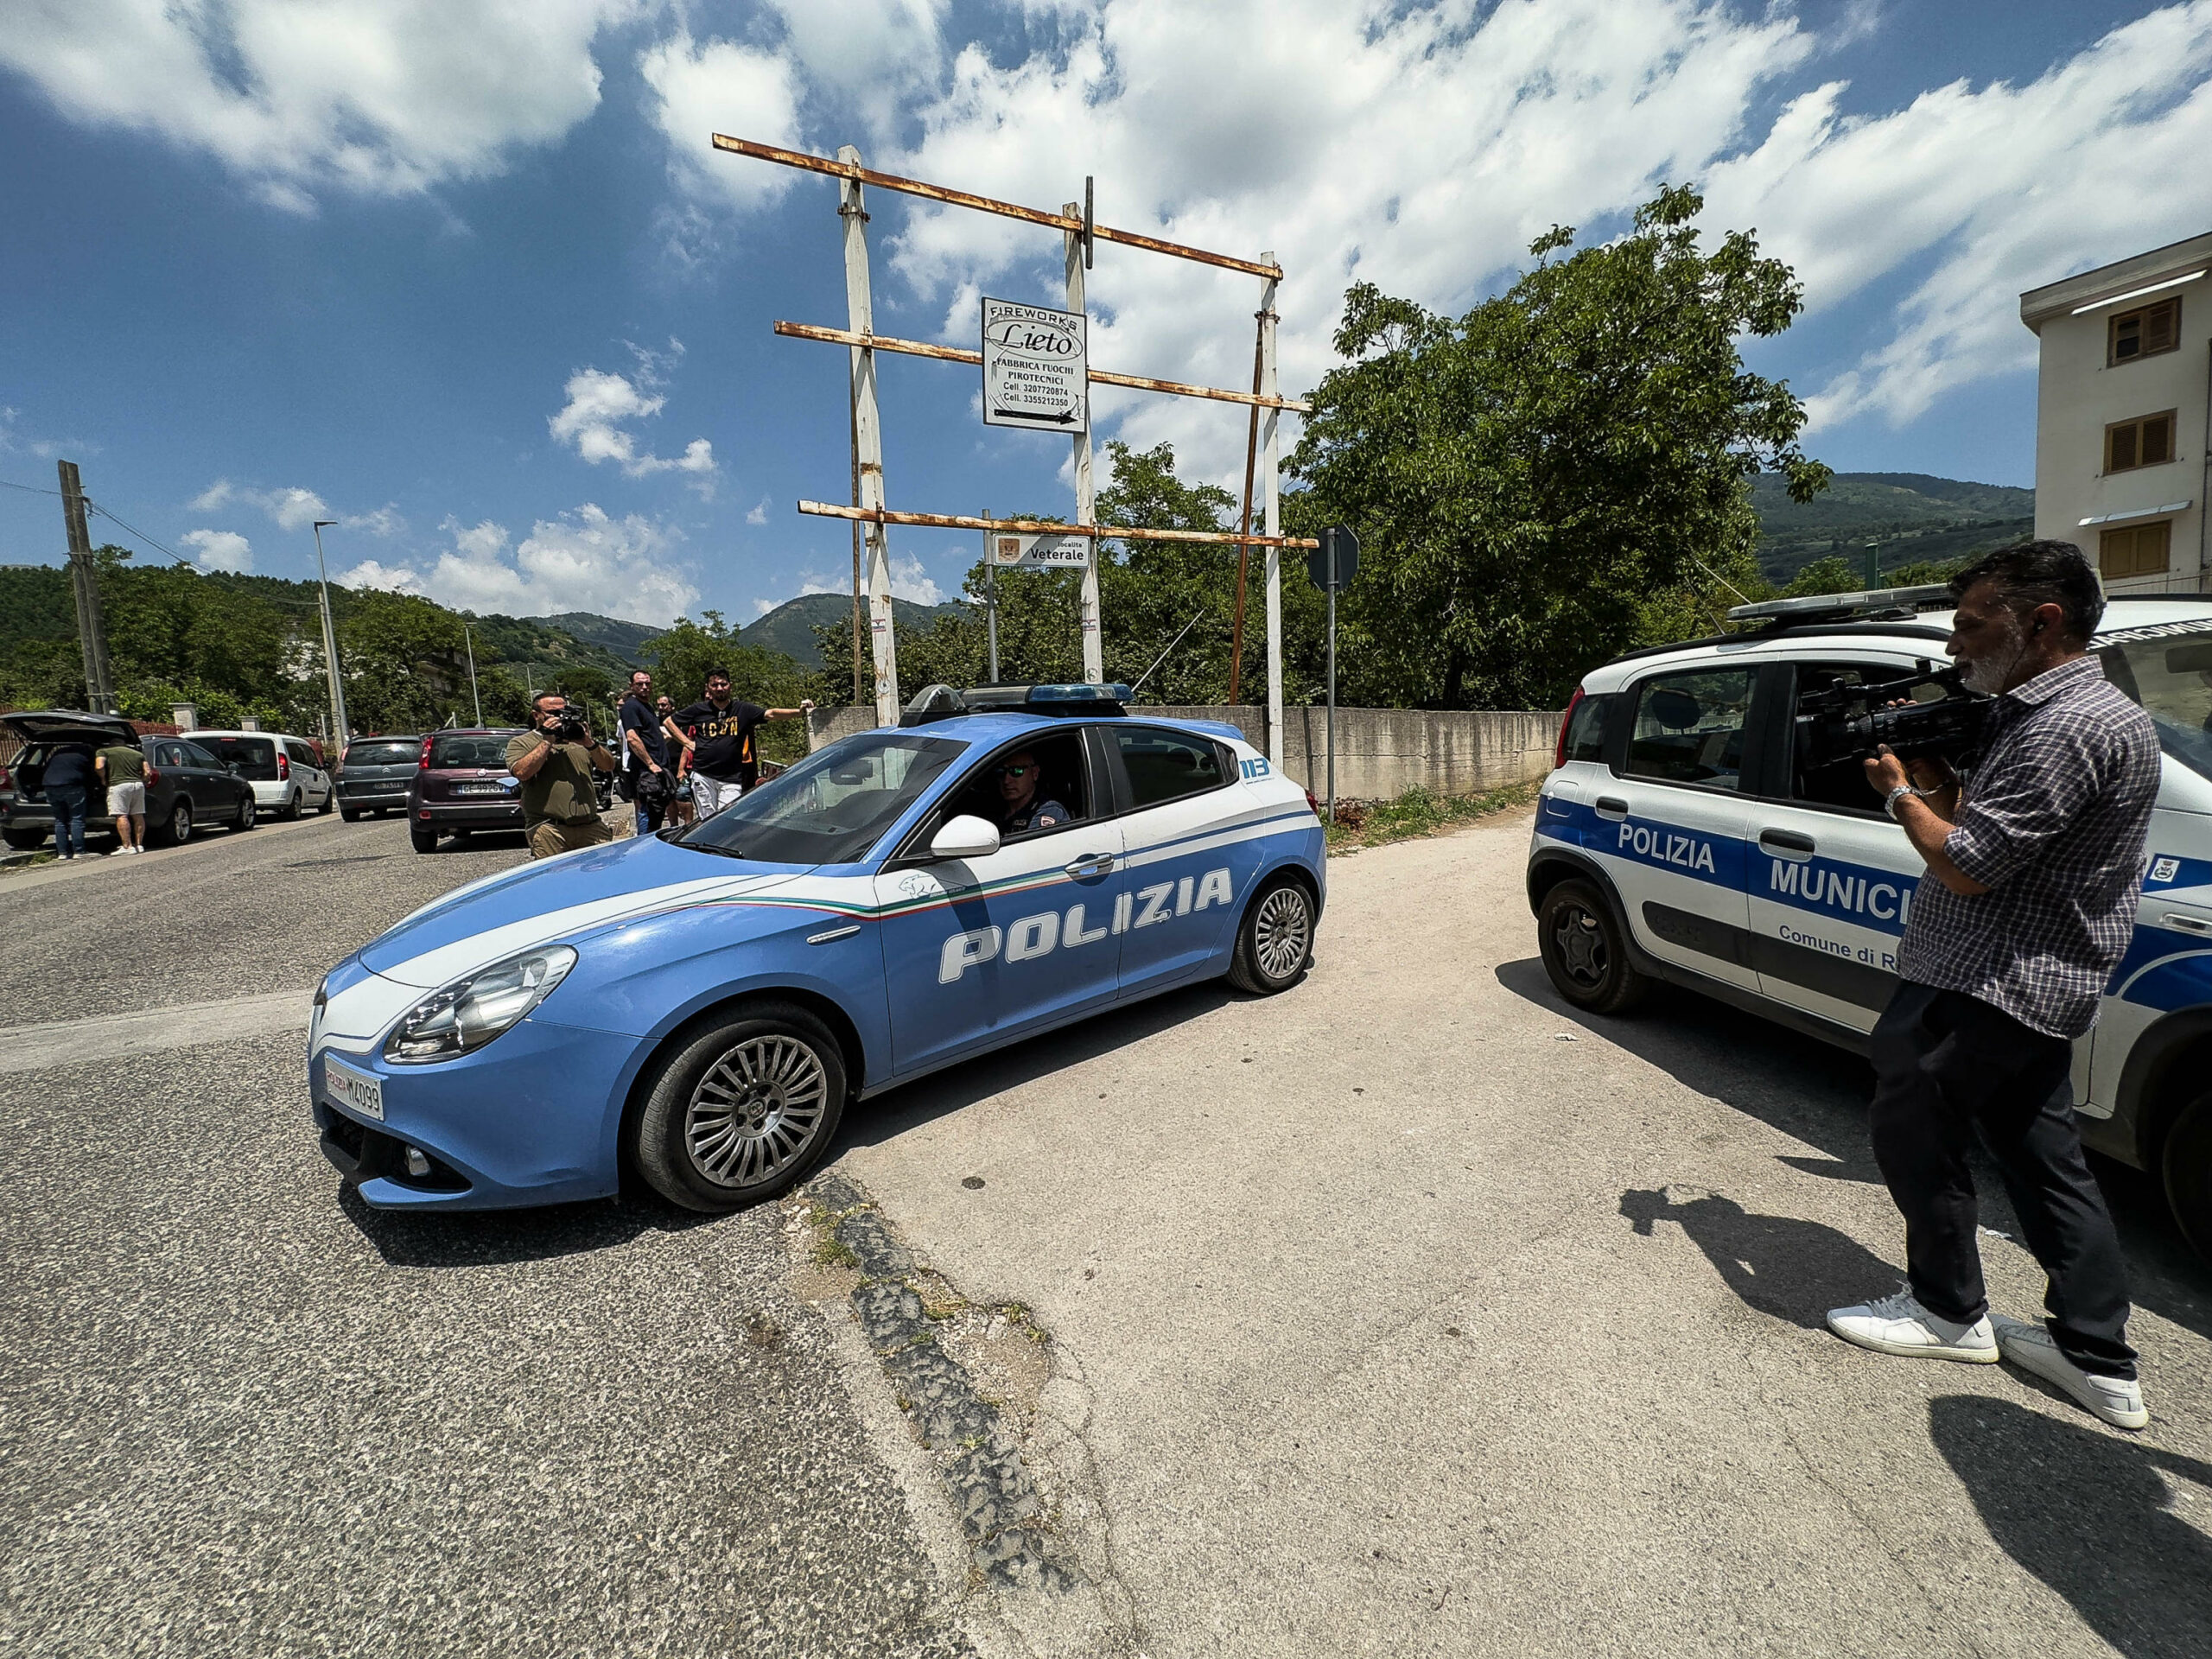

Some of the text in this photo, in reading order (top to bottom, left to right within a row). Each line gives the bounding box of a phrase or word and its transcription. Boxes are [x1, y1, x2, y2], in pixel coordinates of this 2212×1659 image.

[990, 307, 1077, 331] FIREWORKS
[998, 323, 1072, 354] Lieto
[996, 358, 1074, 375] FABBRICA FUOCHI
[1003, 381, 1068, 396] Cell. 3207720874
[1008, 371, 1064, 385] PIROTECNICI
[1003, 392, 1069, 407] Cell. 3355212350
[1030, 548, 1084, 561] Veterale
[1239, 757, 1270, 779] 113
[1618, 823, 1911, 925] POLIZIA MUNICI
[938, 868, 1232, 984] POLIZIA
[1779, 925, 1897, 971] Comune di R
